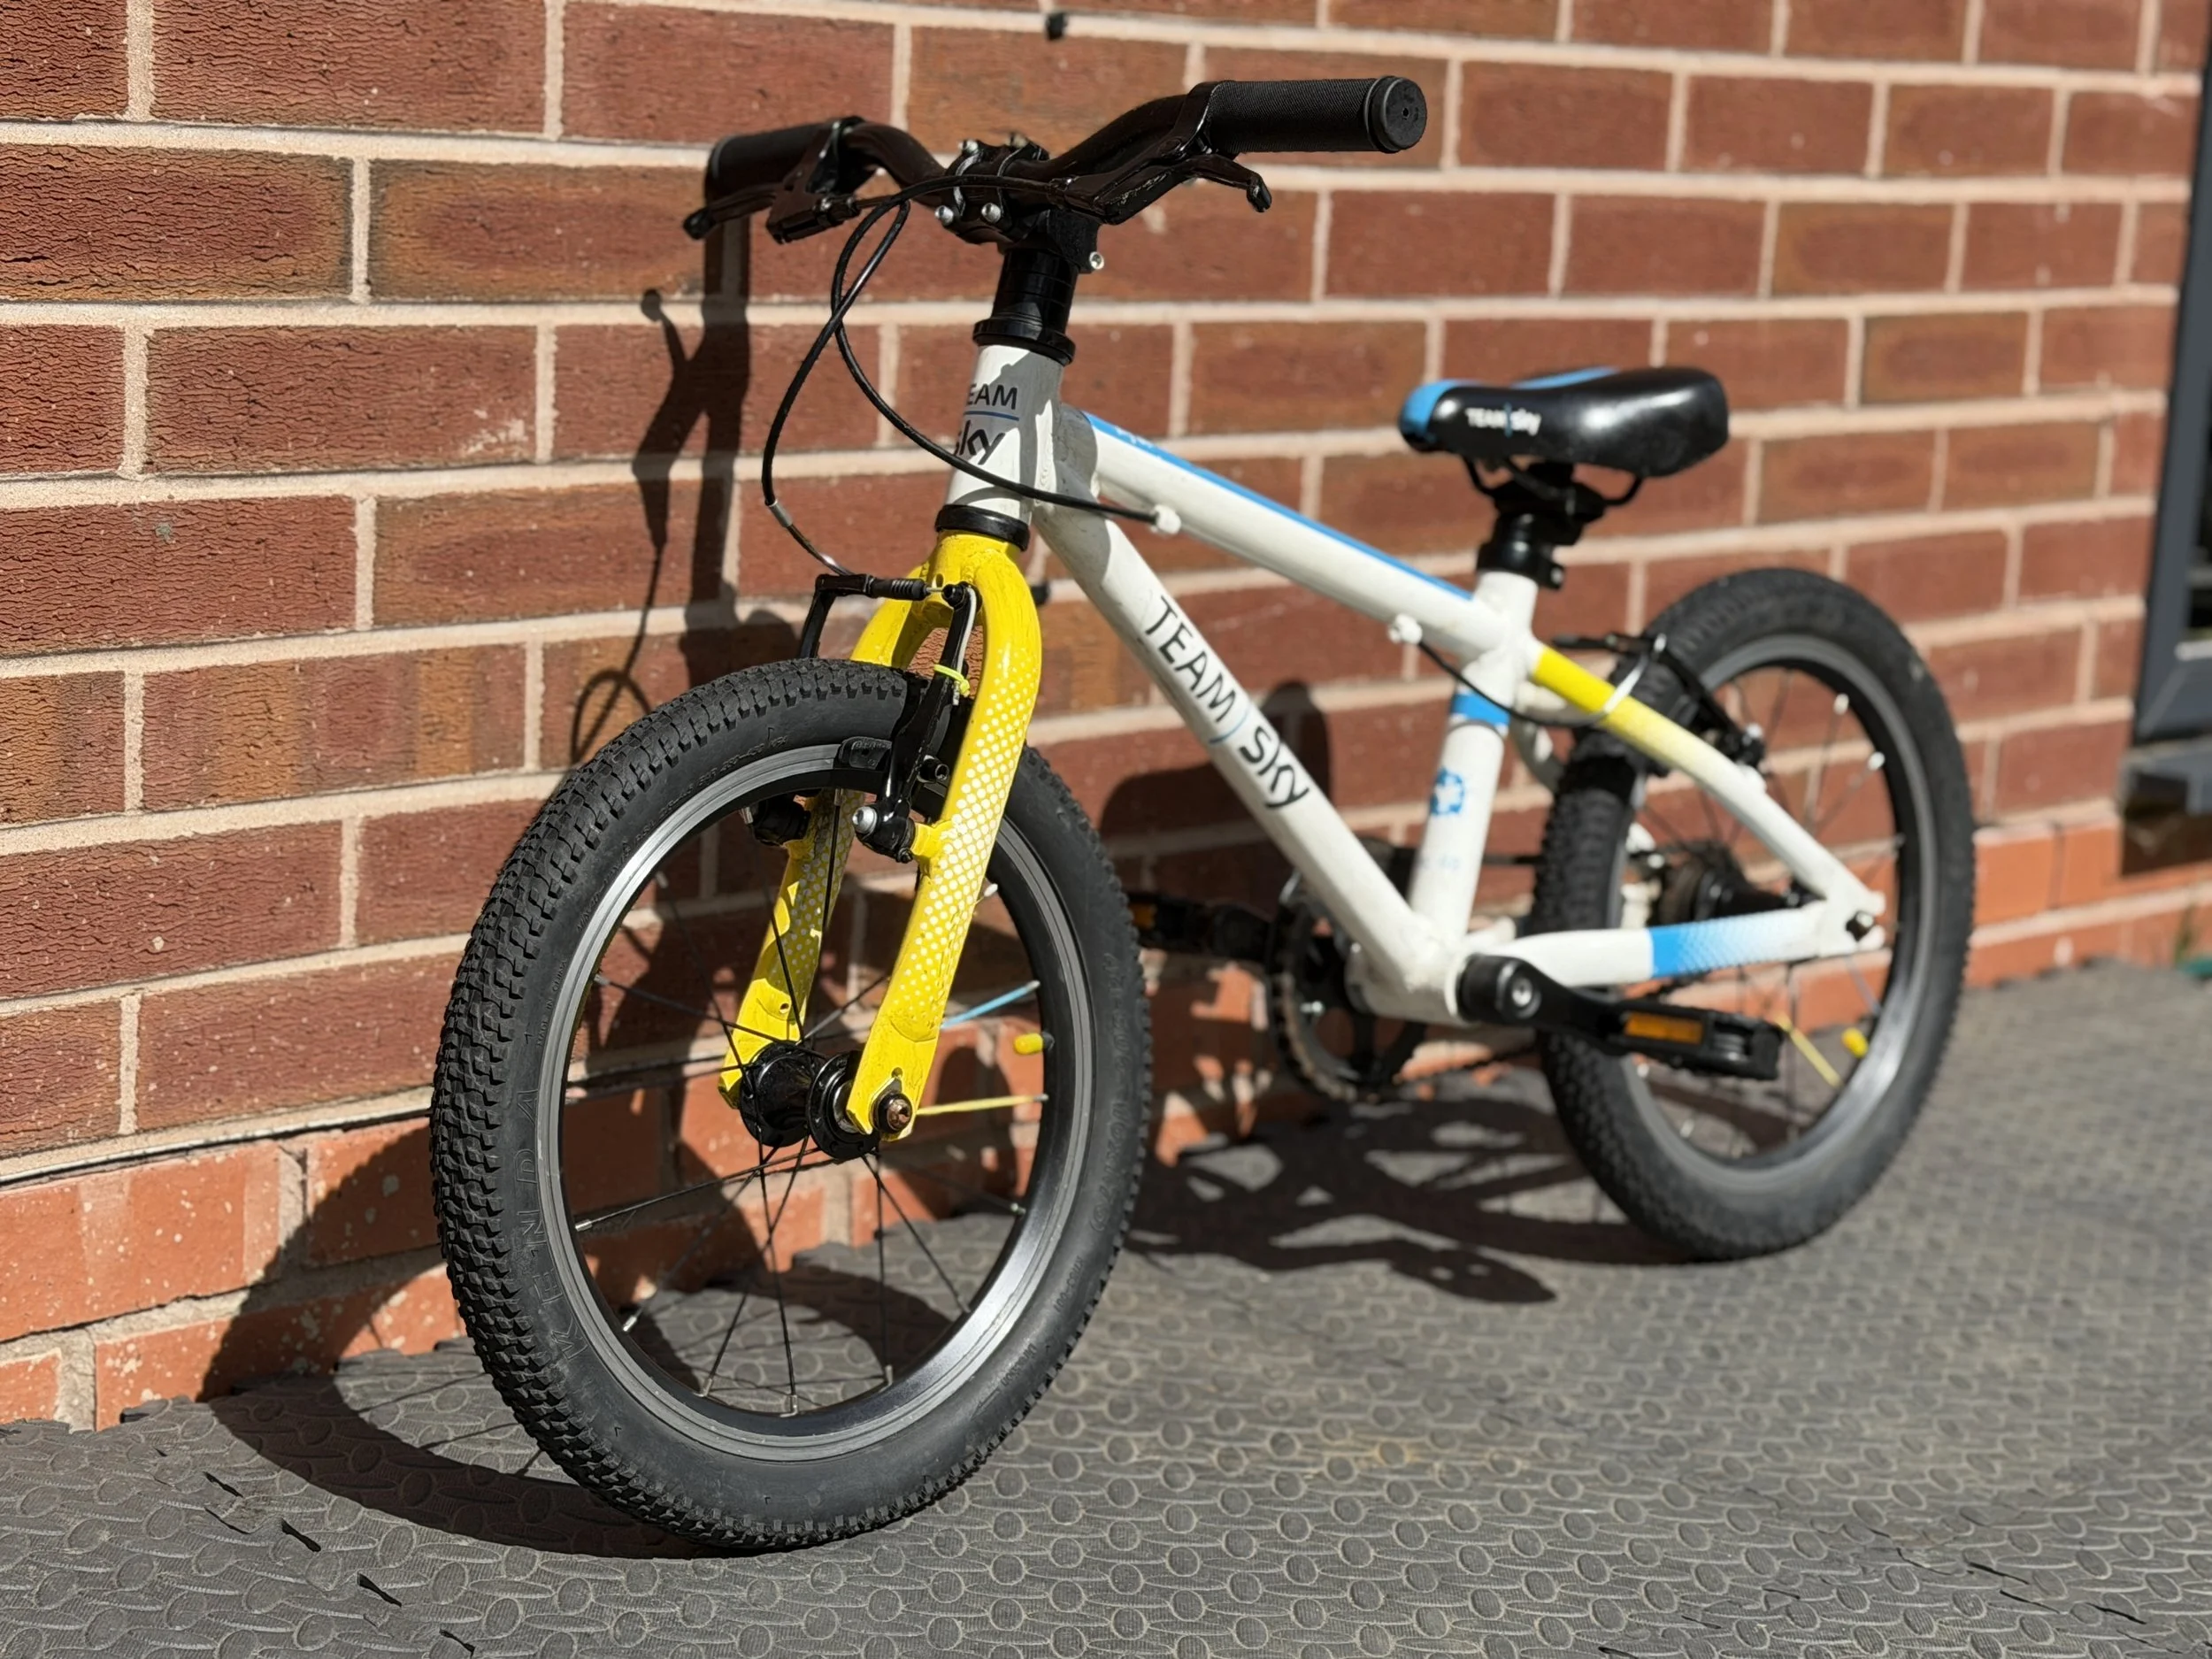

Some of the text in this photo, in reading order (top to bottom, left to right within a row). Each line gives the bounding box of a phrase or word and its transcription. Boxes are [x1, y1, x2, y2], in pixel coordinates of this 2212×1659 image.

[967, 383, 1018, 410] EAM
[1464, 408, 1507, 428] TEAM
[1145, 595, 1237, 724] TEAM
[514, 1088, 589, 1362] KENDA
